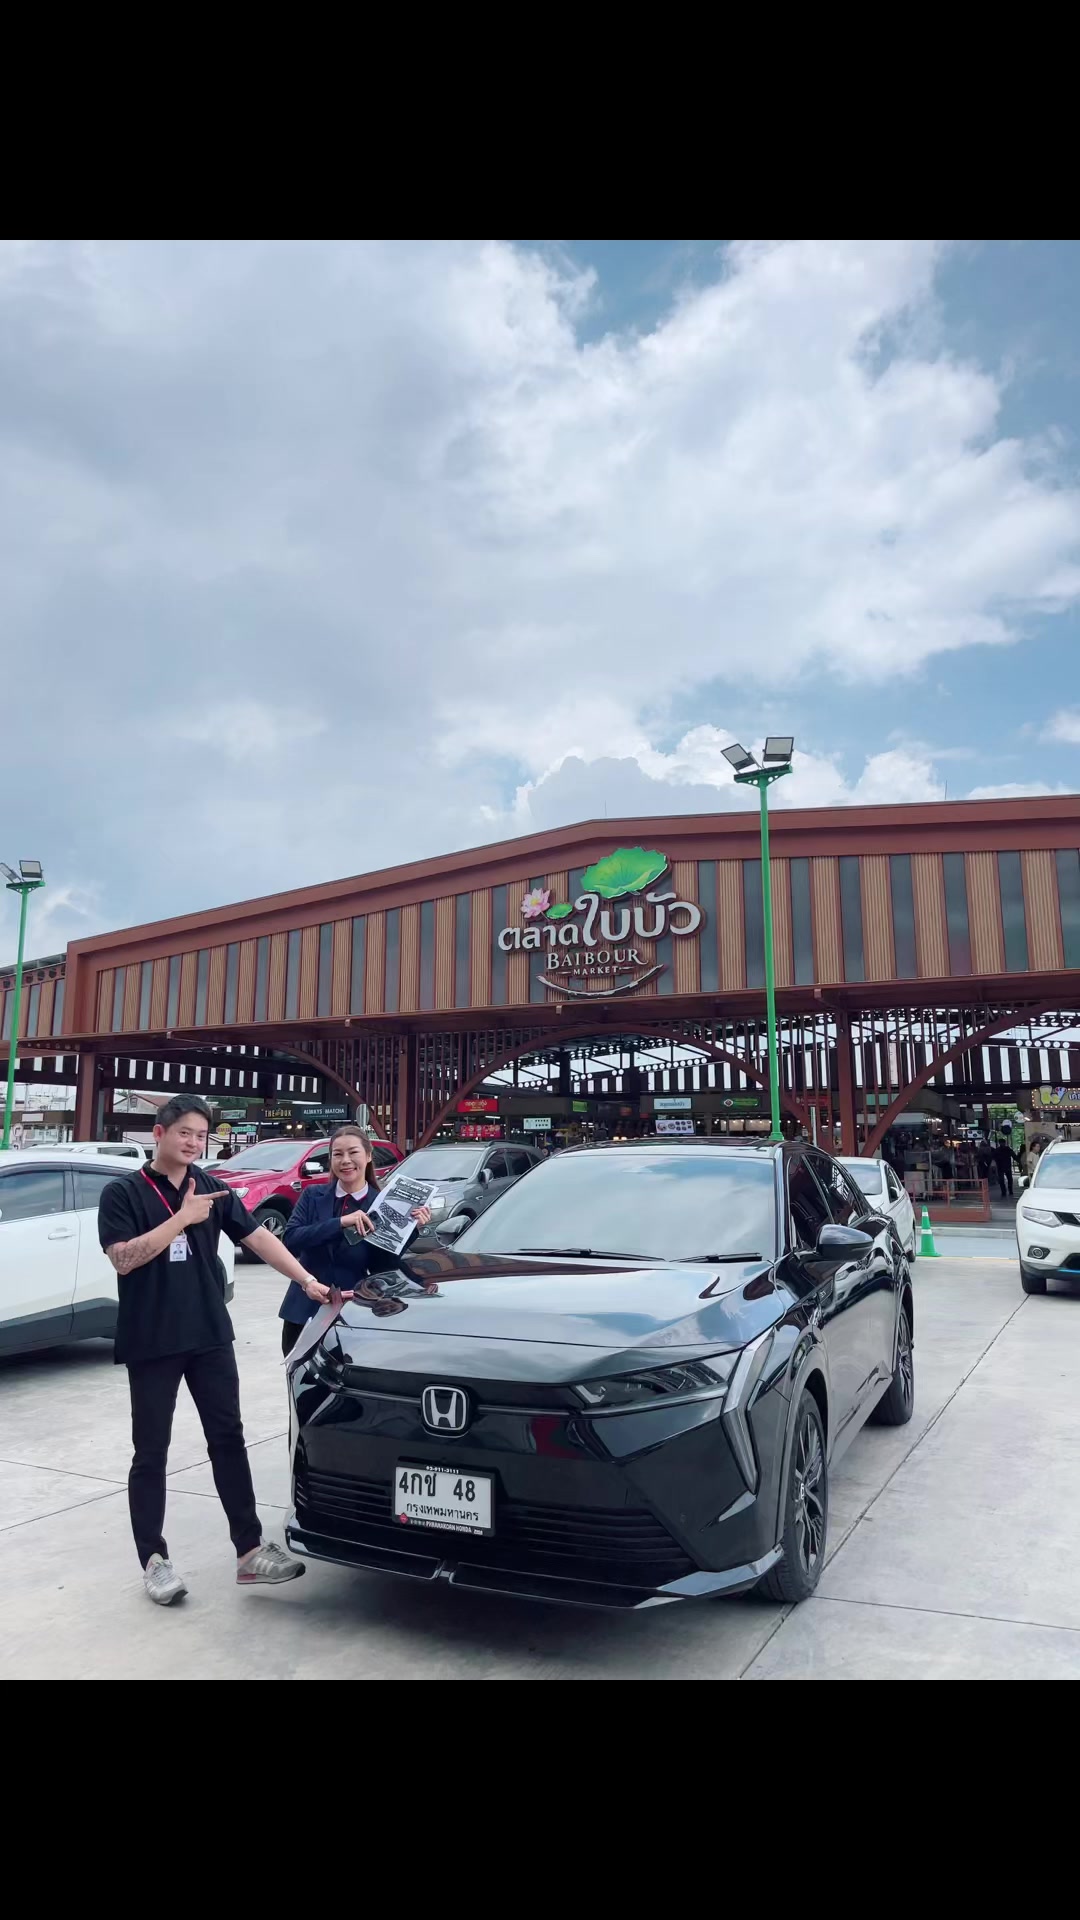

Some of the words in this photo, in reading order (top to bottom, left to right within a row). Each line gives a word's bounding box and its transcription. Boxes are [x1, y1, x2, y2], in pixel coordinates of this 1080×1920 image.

[547, 949, 648, 970] BAIBOUR
[573, 965, 619, 976] MARKET
[453, 1478, 476, 1502] 48
[406, 1502, 479, 1521] กรุงเทพมหานคร
